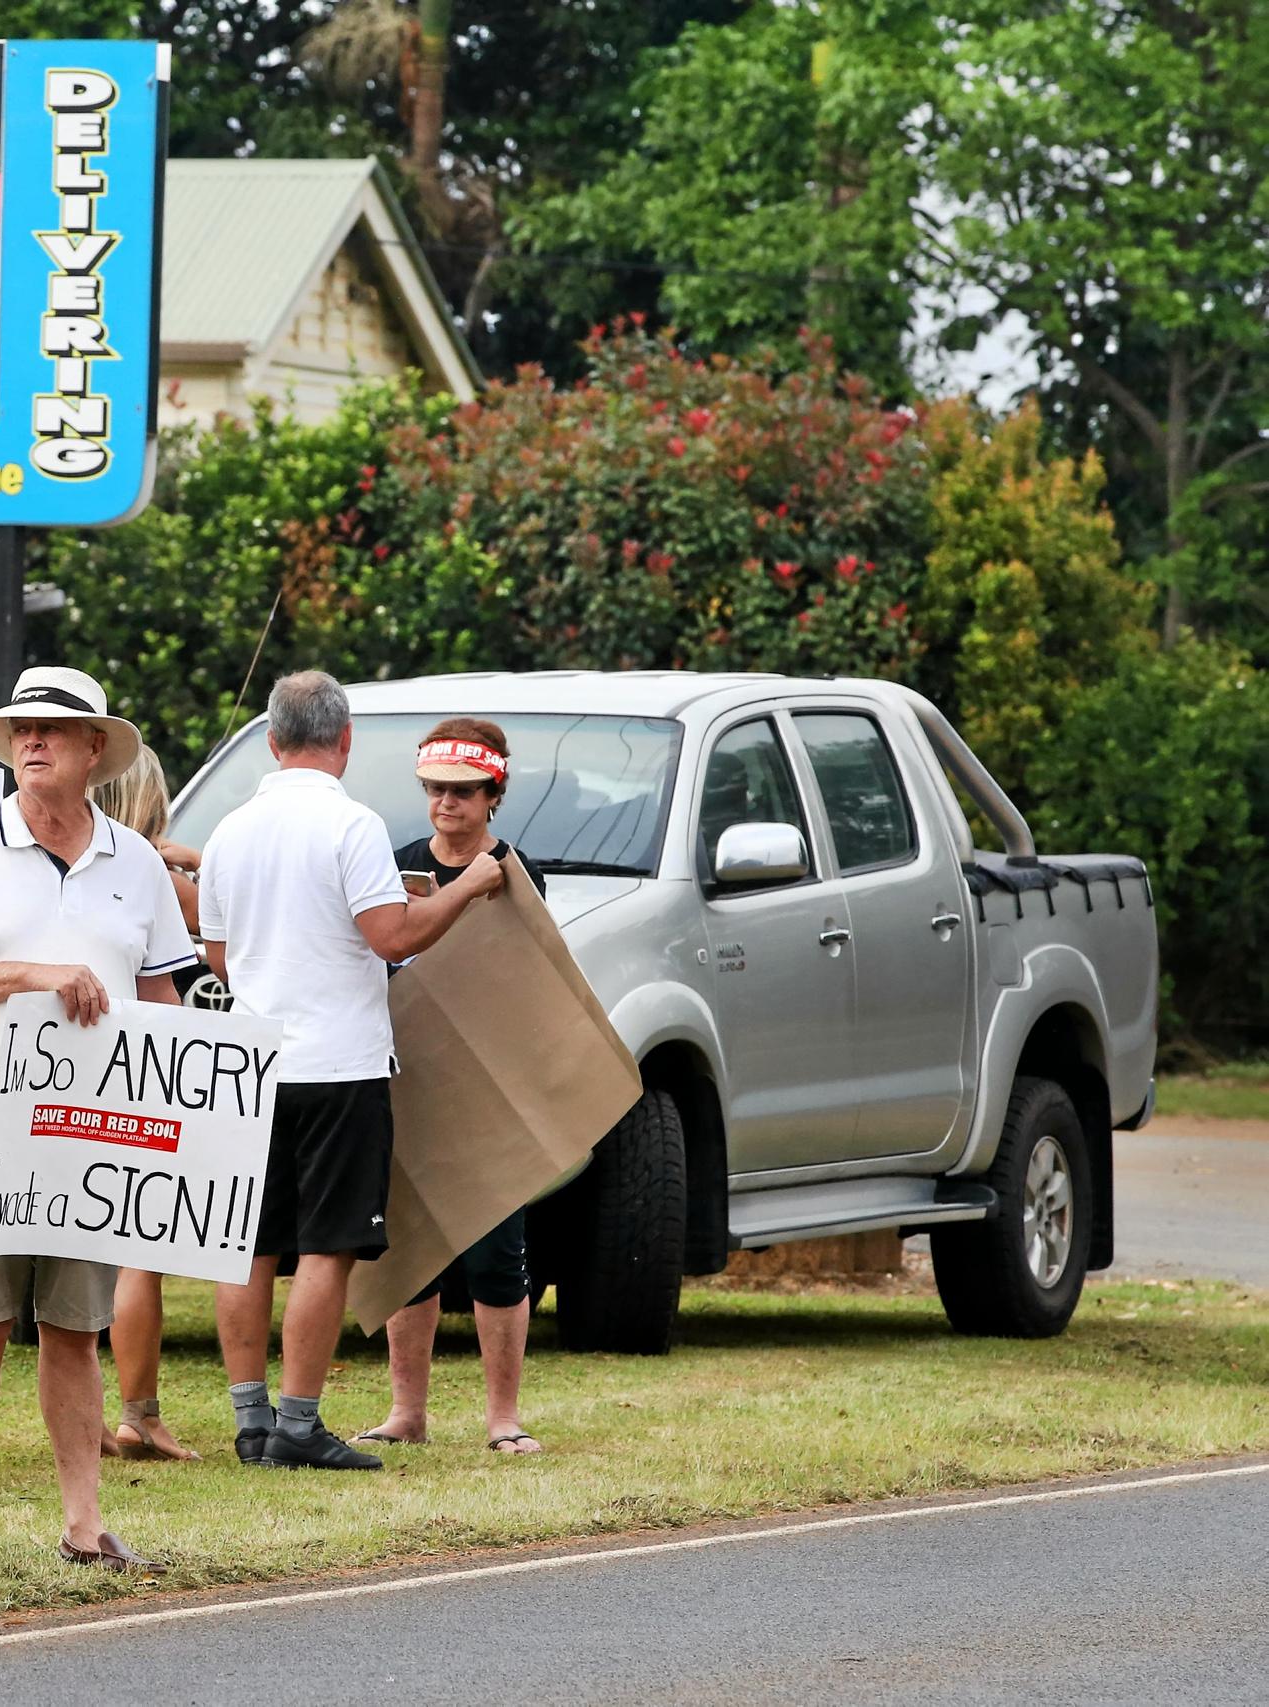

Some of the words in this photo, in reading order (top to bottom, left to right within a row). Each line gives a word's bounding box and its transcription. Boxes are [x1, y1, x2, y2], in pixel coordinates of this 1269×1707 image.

[31, 69, 121, 479] DELIVERING
[456, 743, 482, 758] RED
[96, 1030, 277, 1117] ANGRY
[33, 1108, 66, 1124] SAVE
[70, 1111, 102, 1128] OUR
[107, 1116, 138, 1132] RED
[143, 1121, 177, 1139] SOIL
[47, 1194, 69, 1227] a
